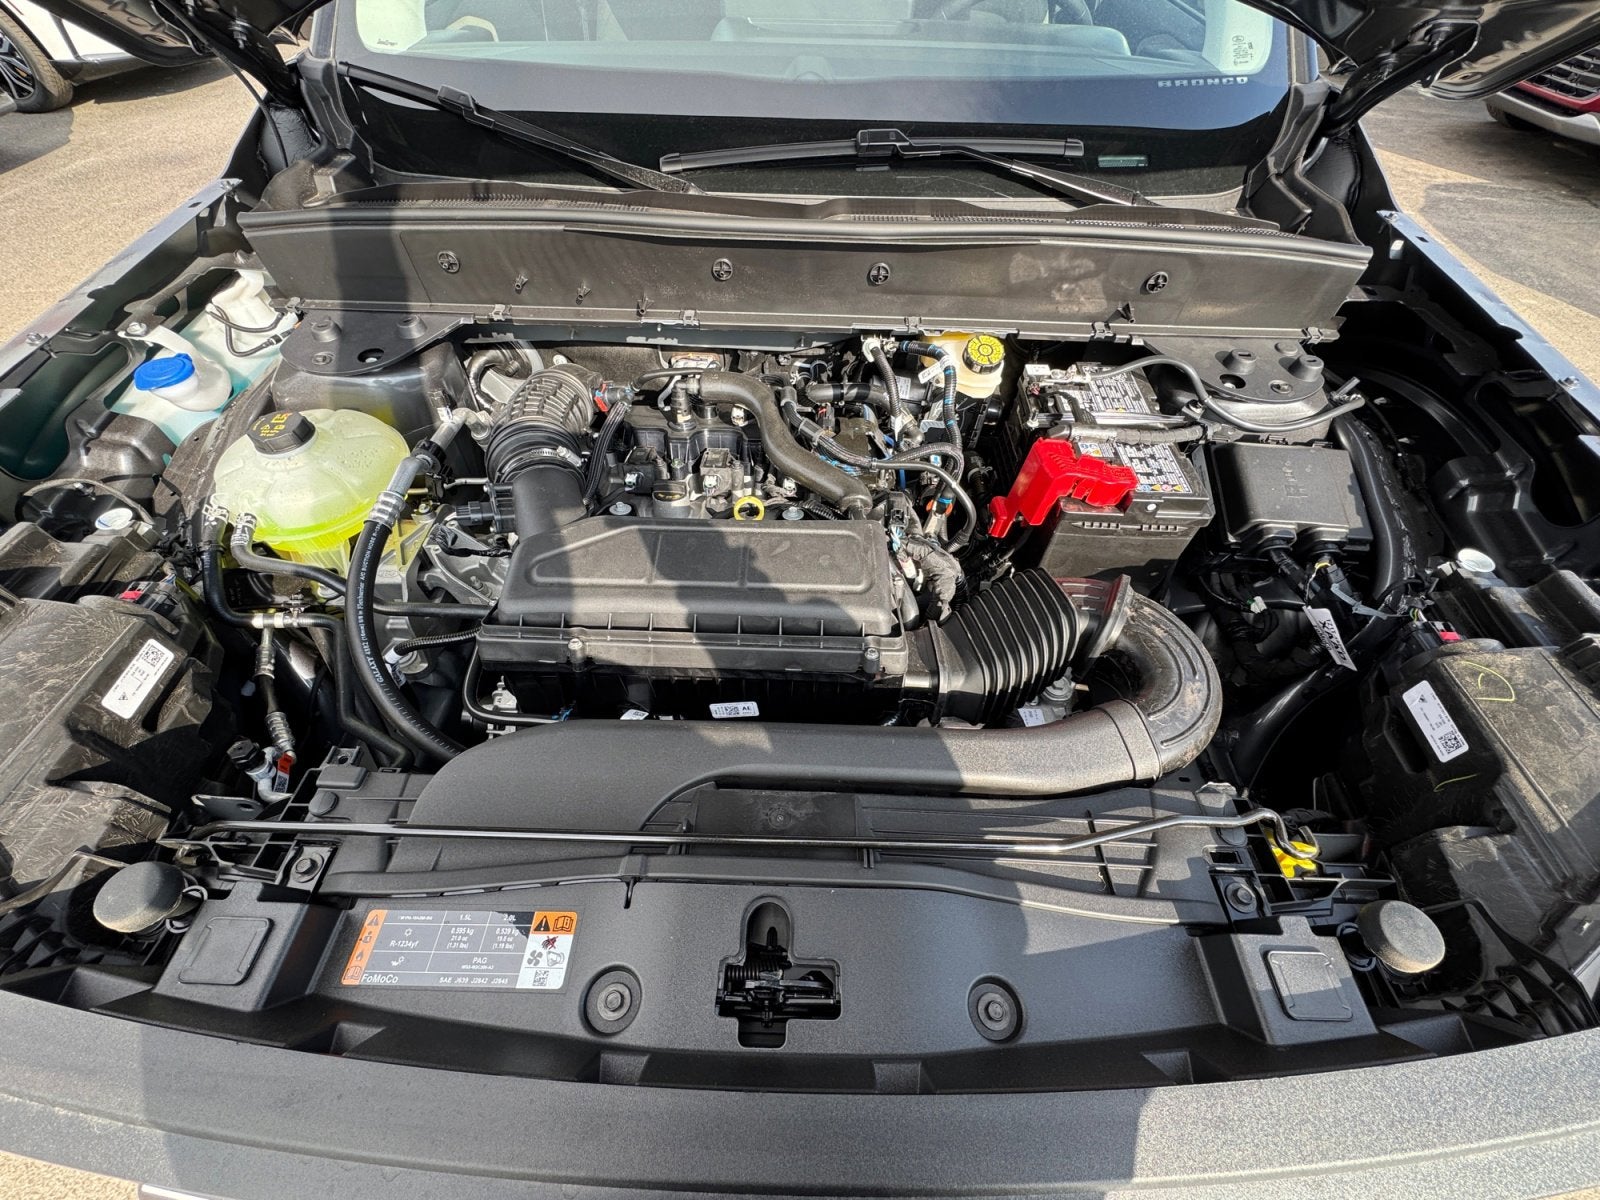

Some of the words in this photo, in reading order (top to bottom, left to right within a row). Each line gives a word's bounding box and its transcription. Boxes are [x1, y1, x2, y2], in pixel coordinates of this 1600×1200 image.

[1157, 76, 1248, 87] BRONCO
[367, 537, 376, 551] HOSE
[361, 550, 371, 572] SUCTION
[366, 656, 384, 683] GALAXY
[503, 913, 516, 921] 2.0L
[467, 927, 475, 936] kg
[511, 928, 519, 937] kg
[389, 940, 419, 949] R-1234yf
[472, 956, 488, 964] PAG
[361, 973, 399, 984] FoMoCo
[439, 976, 453, 984] SAE
[454, 976, 469, 984] J639
